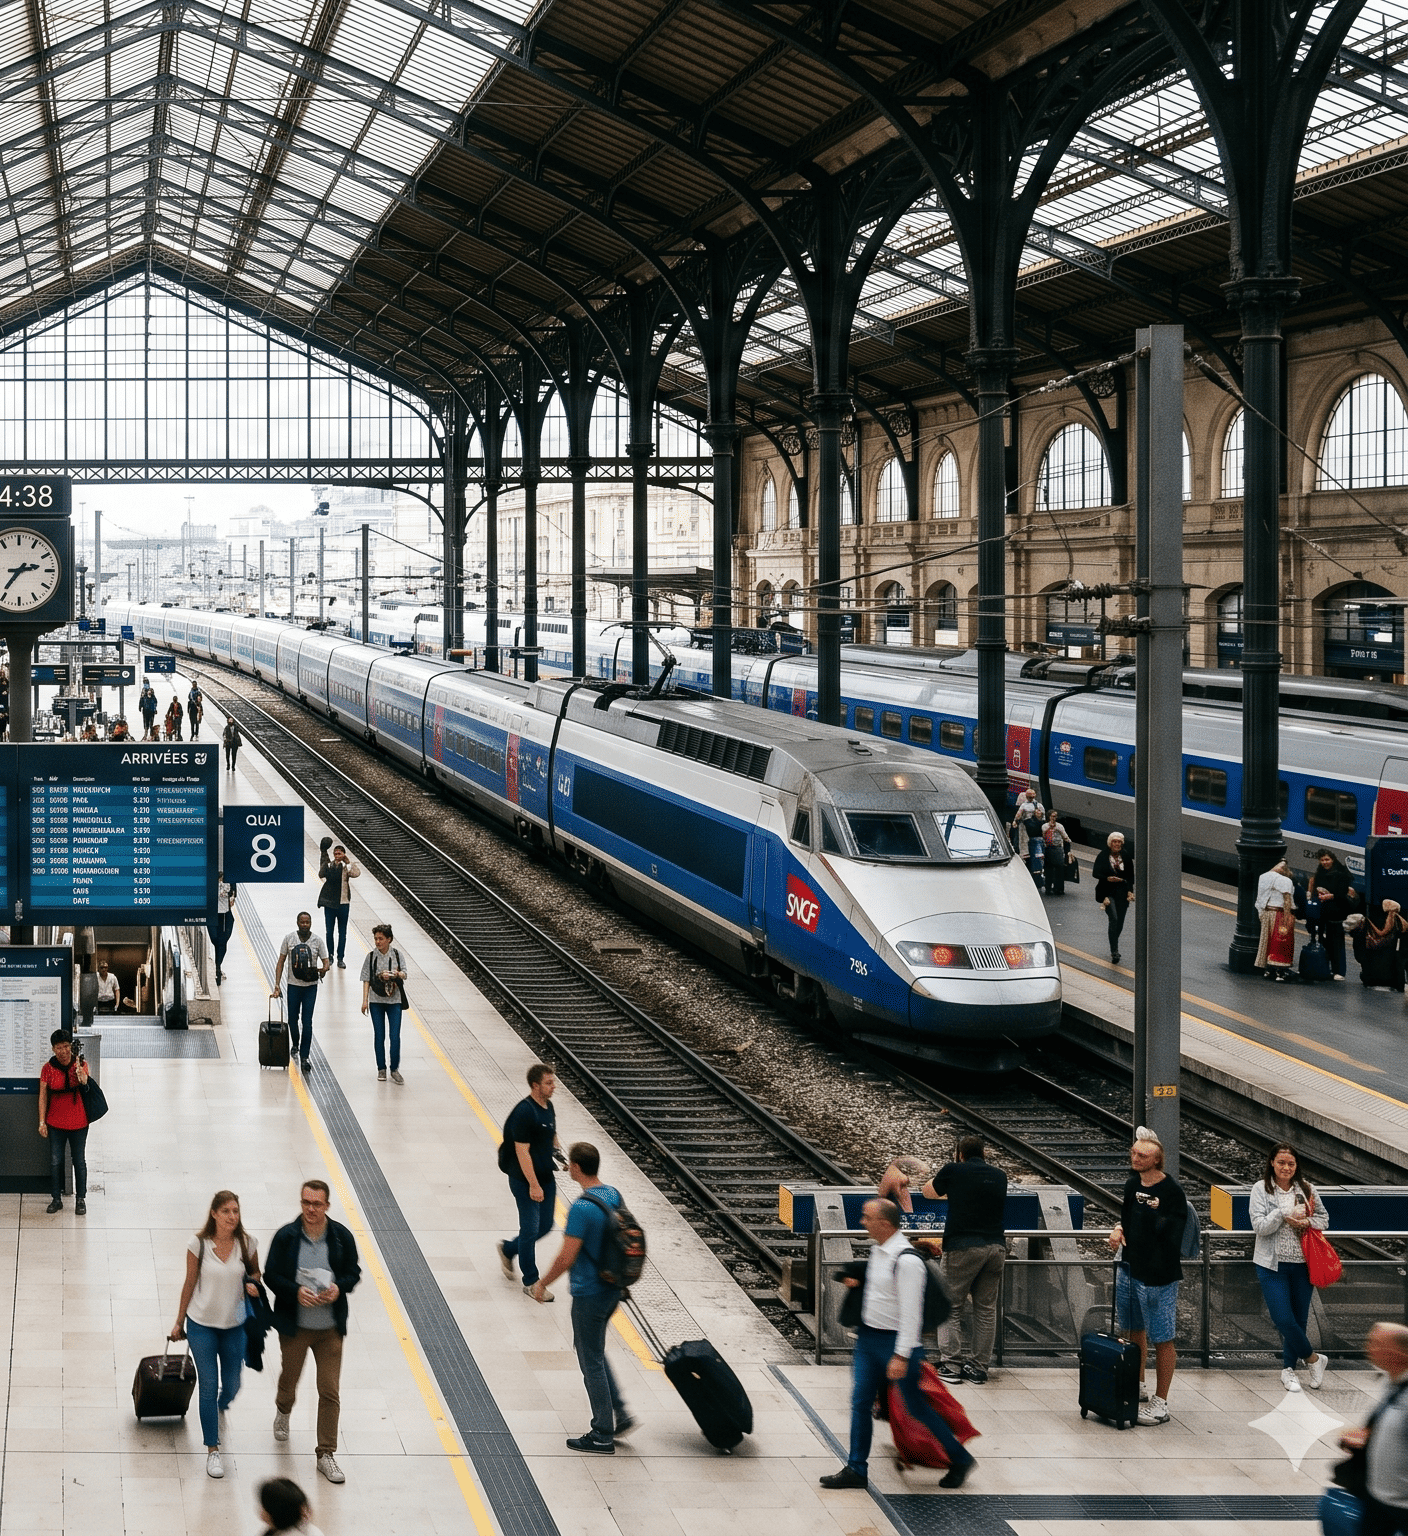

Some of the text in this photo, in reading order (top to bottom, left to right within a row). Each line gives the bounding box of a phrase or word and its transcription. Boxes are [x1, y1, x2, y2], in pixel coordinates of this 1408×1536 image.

[121, 749, 189, 765] ARRIVÉES
[245, 814, 281, 826] QUAI
[250, 833, 277, 873] 8
[786, 893, 819, 925] SNCF
